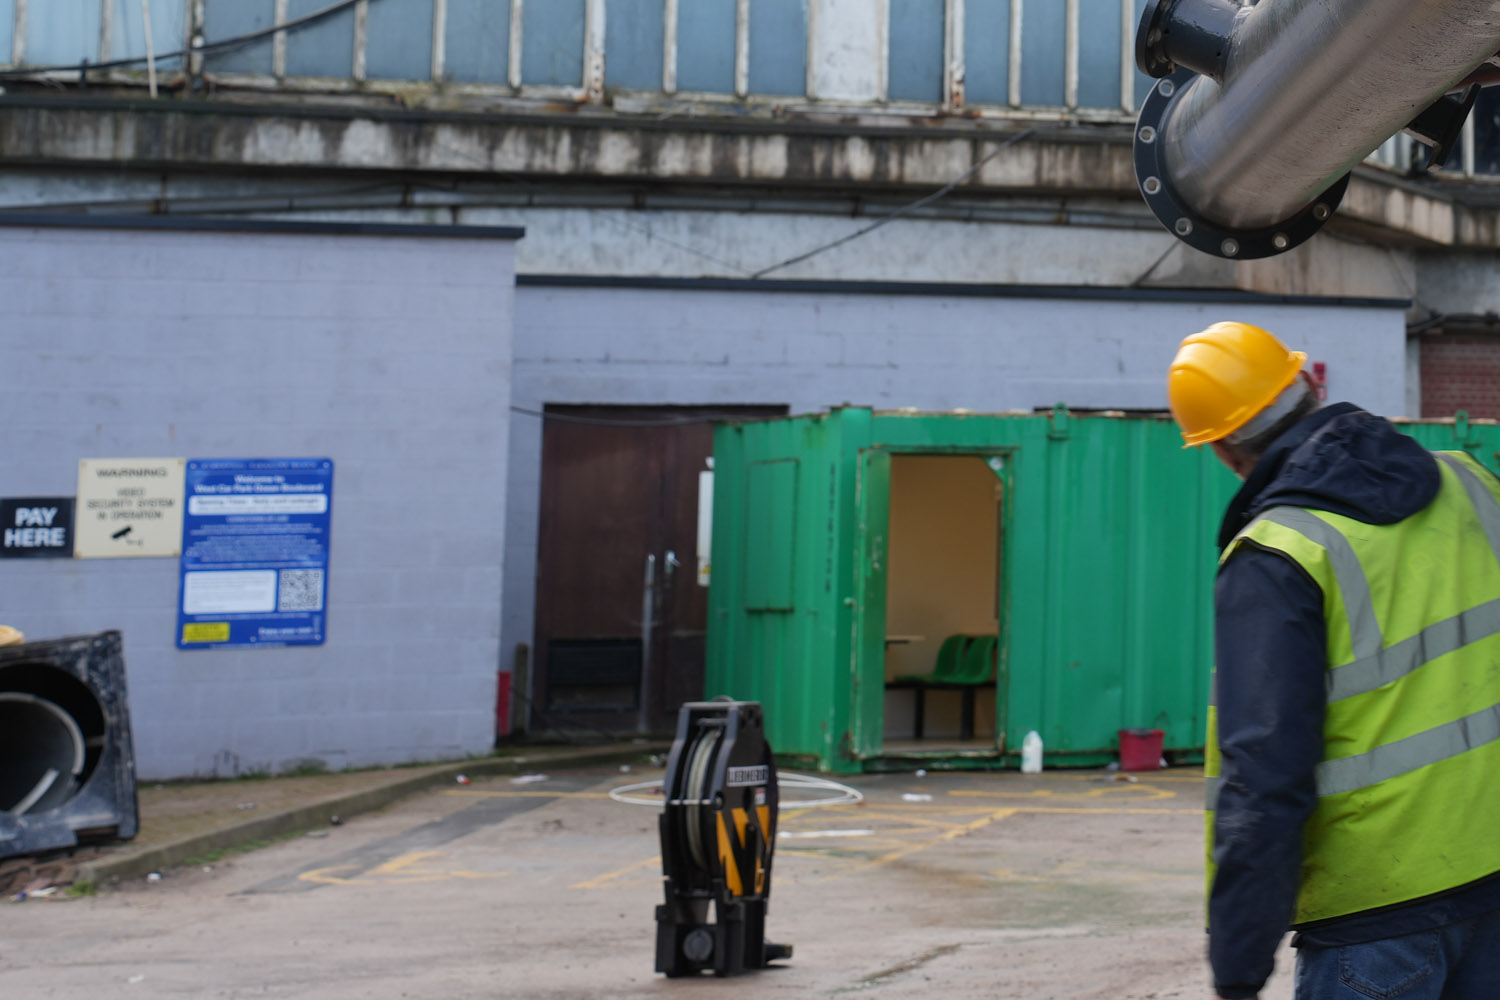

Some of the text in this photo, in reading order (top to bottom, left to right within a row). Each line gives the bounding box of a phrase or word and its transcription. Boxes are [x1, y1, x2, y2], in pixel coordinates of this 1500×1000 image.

[96, 467, 168, 478] WARNING
[87, 498, 175, 510] SECURITY SYSTEM
[15, 506, 59, 527] PAY
[111, 510, 163, 521] OPERATION
[4, 527, 67, 548] HERE
